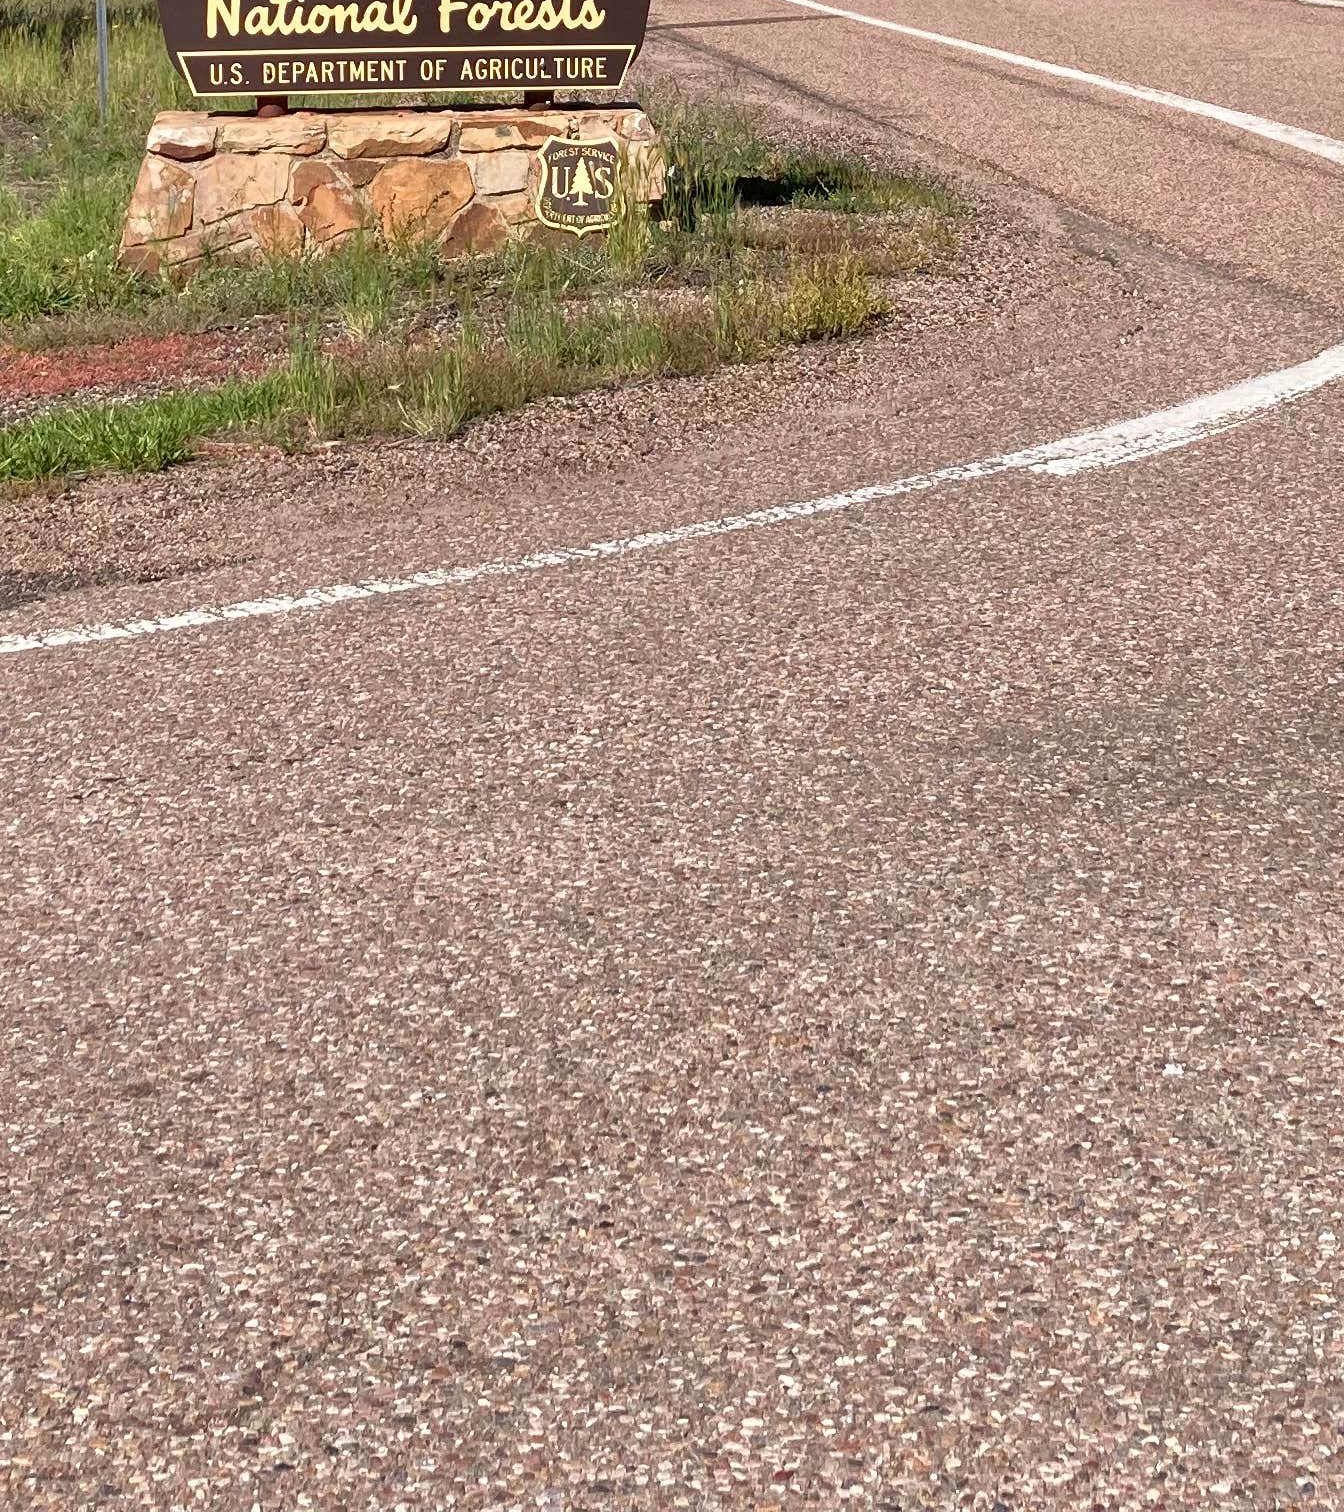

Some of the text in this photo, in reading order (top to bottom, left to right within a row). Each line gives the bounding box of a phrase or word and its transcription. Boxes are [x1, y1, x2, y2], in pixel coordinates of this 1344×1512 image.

[210, 57, 607, 85] U.S. DEPARTMENT OF AGRICULTURE
[581, 147, 615, 164] SERVICE
